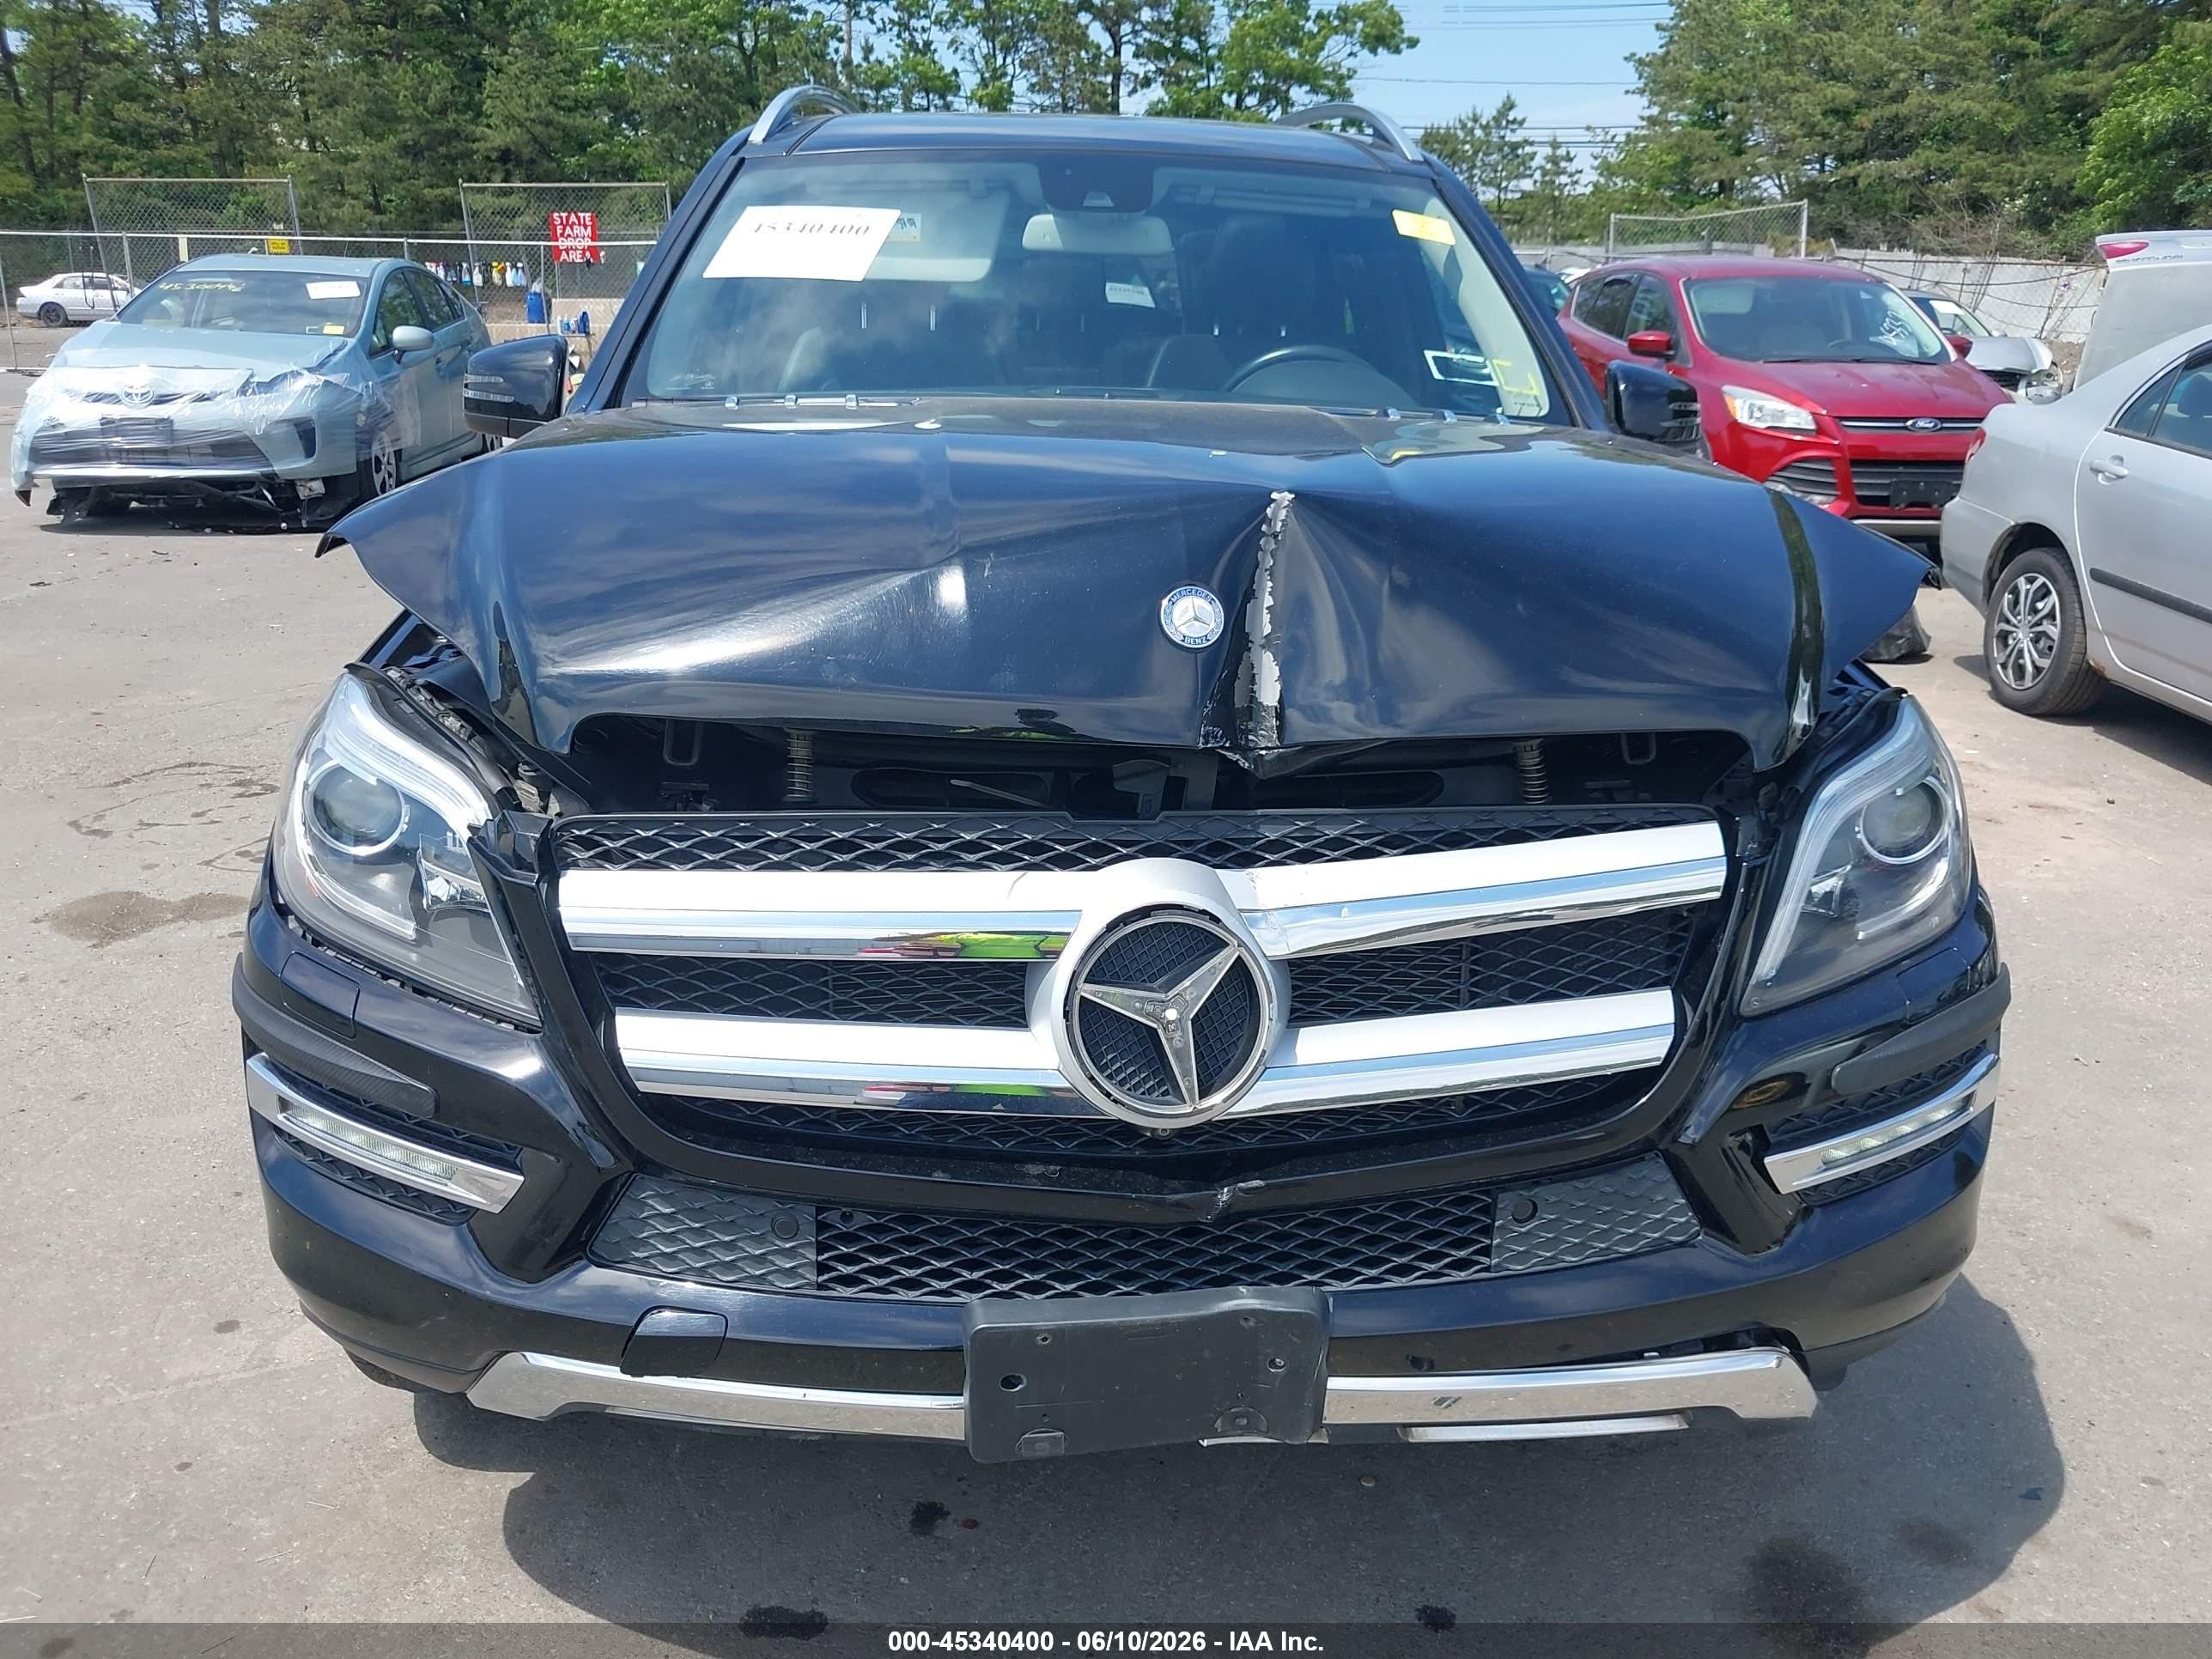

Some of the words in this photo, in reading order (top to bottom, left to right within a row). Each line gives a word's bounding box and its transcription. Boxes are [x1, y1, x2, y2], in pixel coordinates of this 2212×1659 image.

[553, 213, 592, 225] STATE
[556, 225, 592, 238] FARM
[559, 238, 592, 249] DROP
[560, 251, 593, 263] AREA
[1171, 589, 1212, 602] MERCEDES
